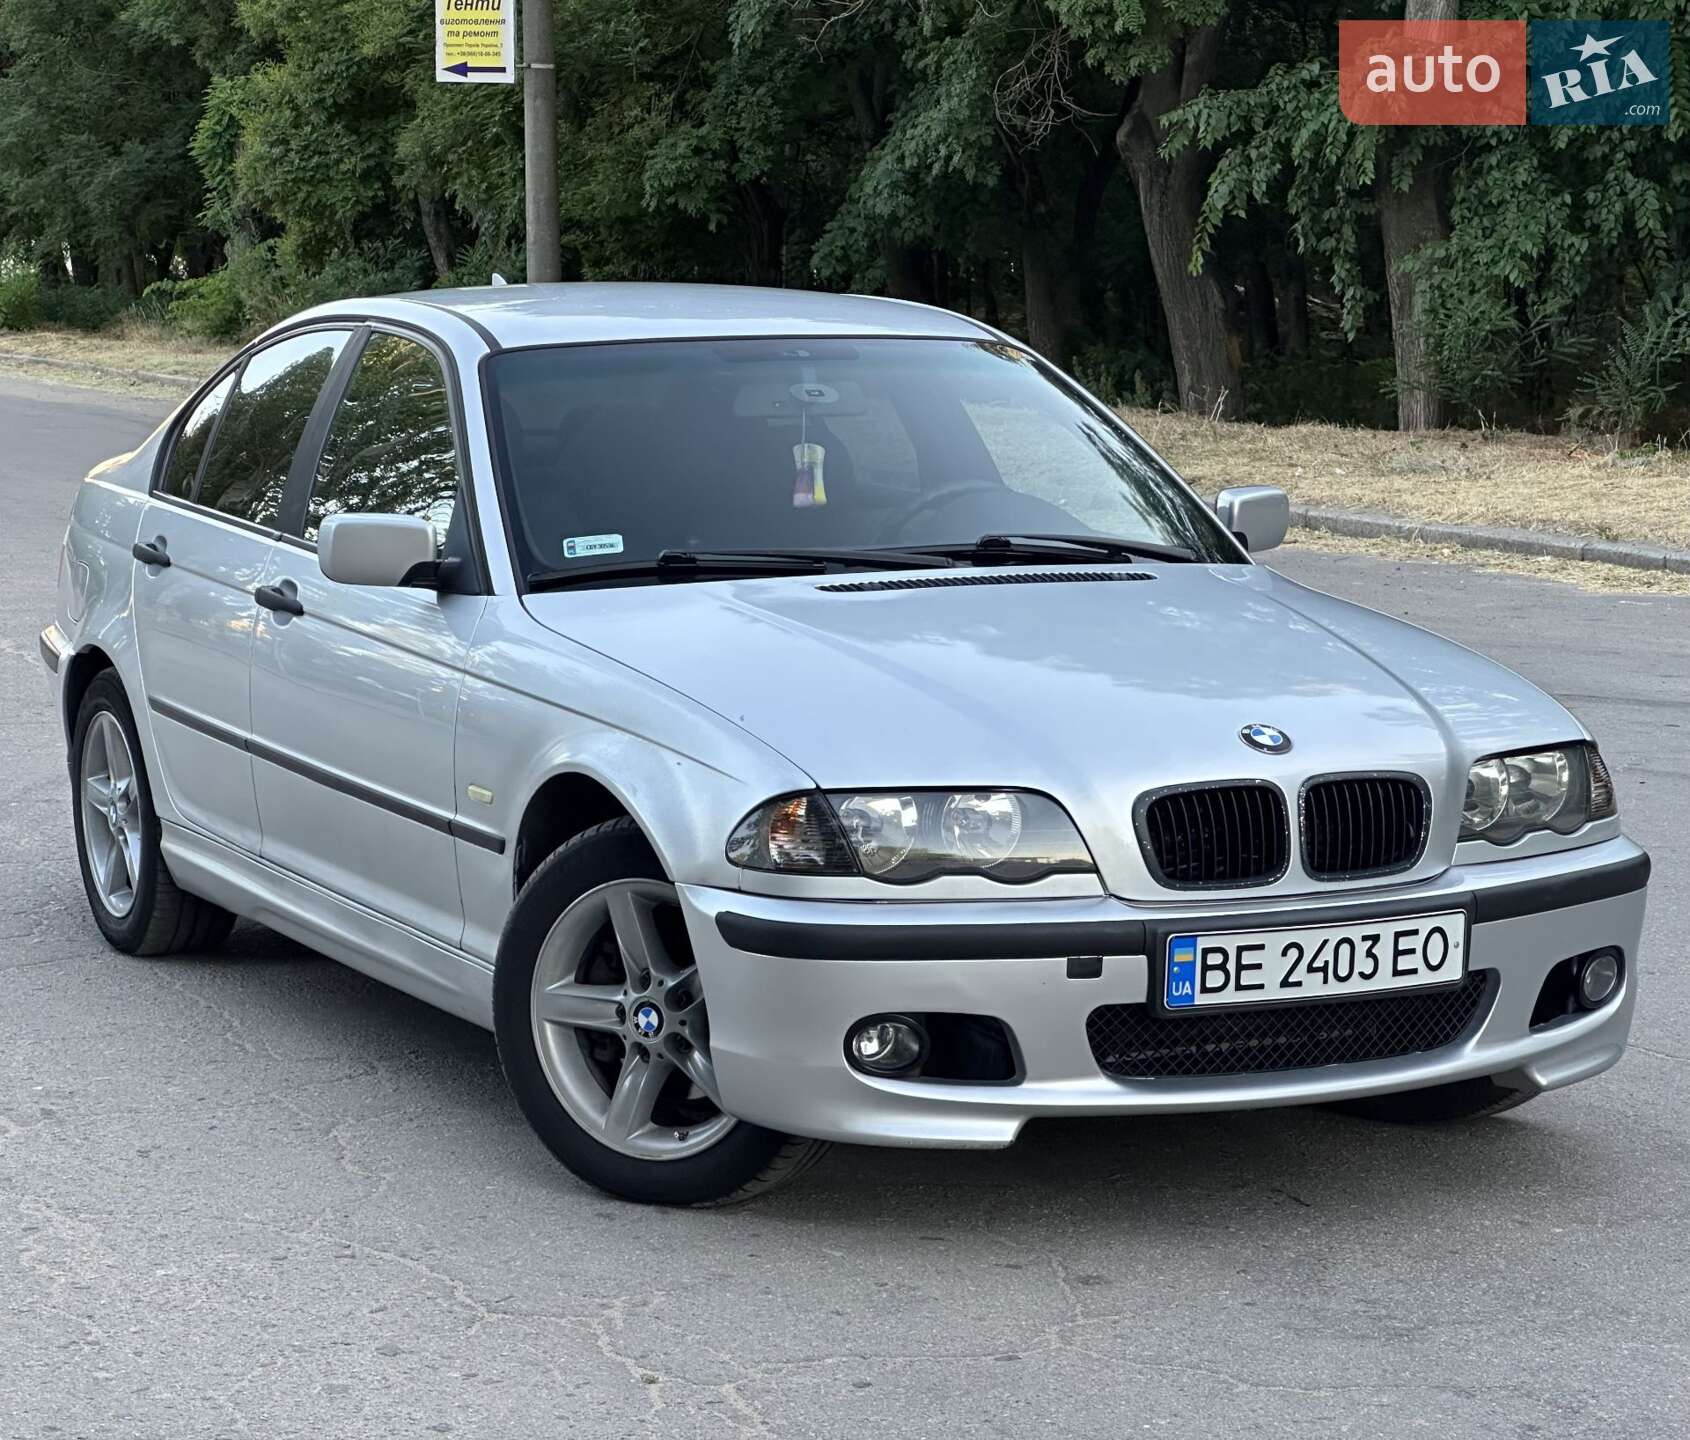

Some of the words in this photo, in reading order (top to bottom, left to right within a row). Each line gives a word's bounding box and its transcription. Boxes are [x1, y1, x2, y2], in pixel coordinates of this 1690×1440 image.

[462, 30, 499, 39] ремонт
[1199, 943, 1266, 994] BE
[1279, 933, 1381, 989] 2403
[1391, 925, 1450, 977] EO
[1172, 982, 1192, 996] UA
